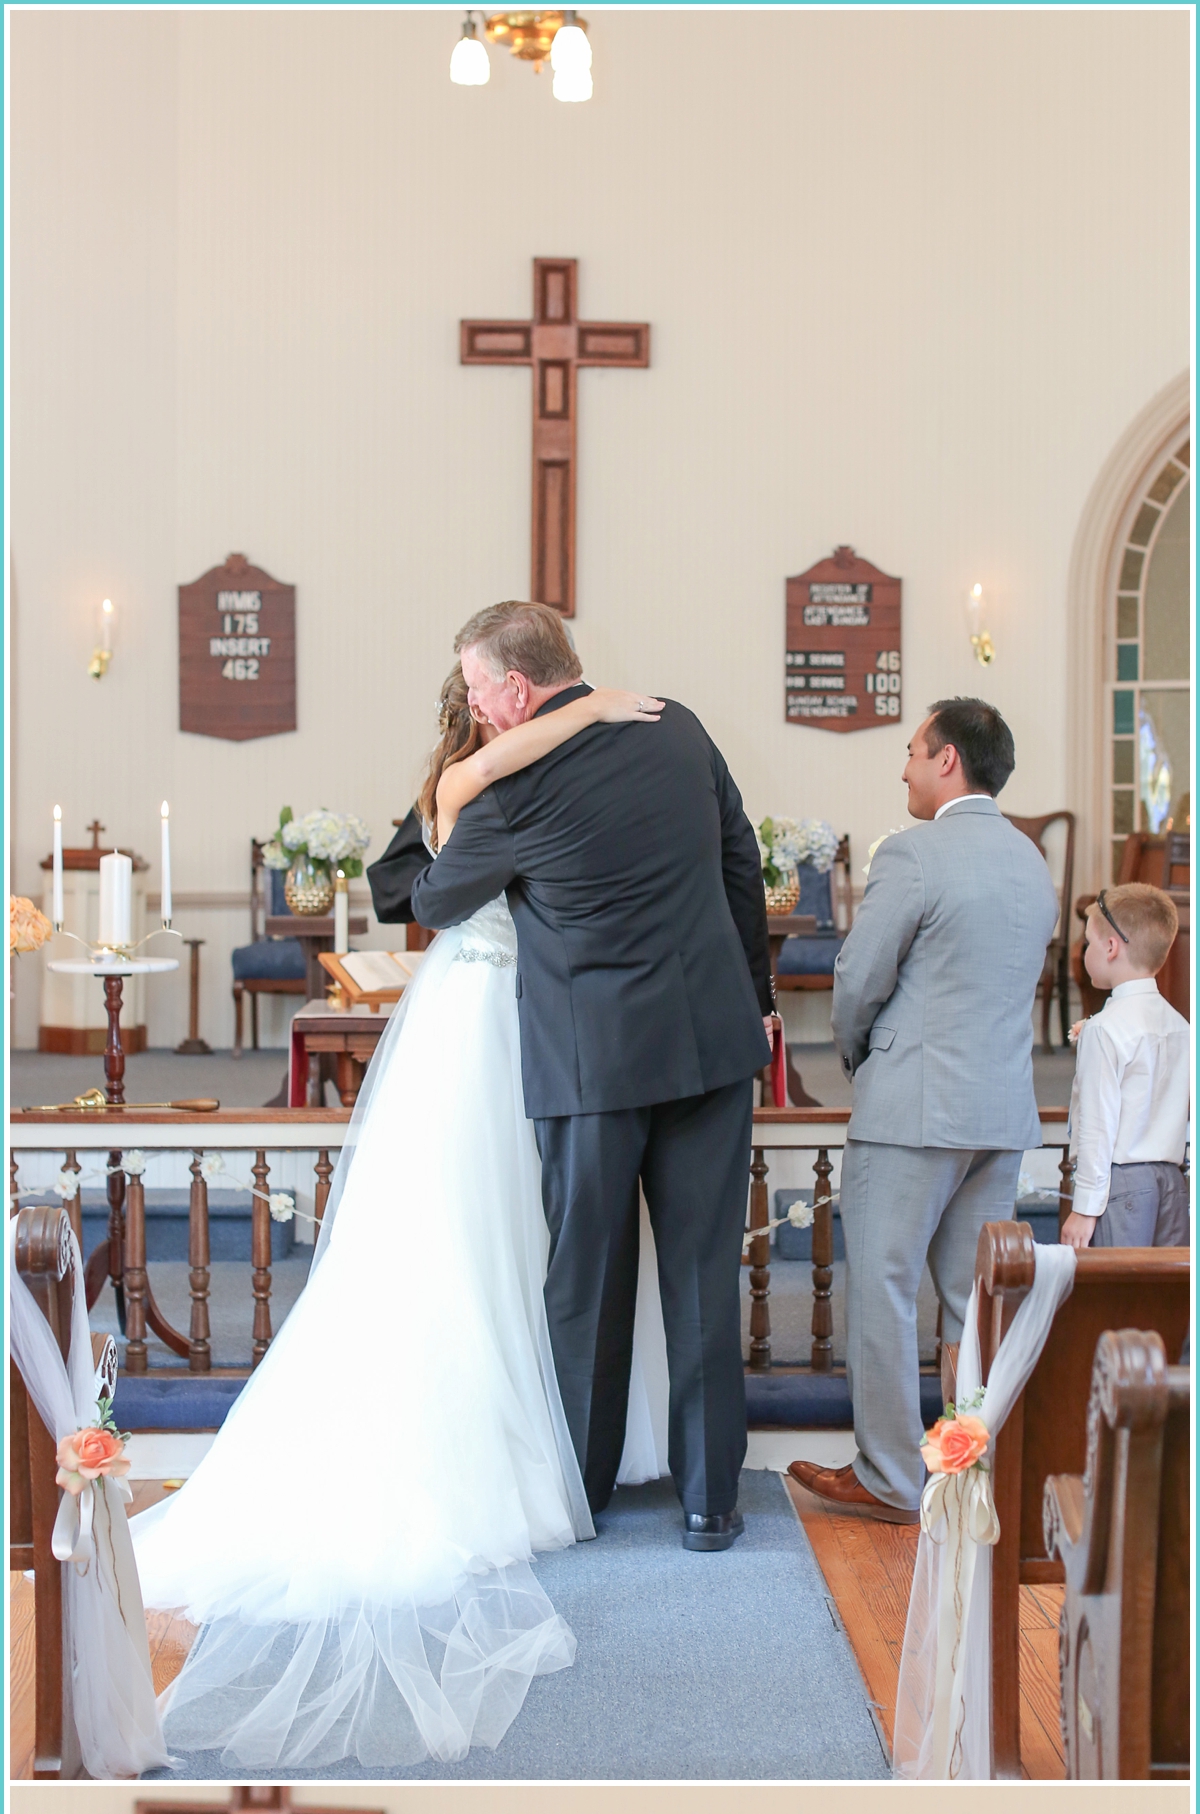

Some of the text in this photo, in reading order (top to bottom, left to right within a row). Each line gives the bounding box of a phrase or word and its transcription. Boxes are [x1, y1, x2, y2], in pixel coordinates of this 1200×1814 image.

[810, 584, 852, 593] REGISTER
[217, 590, 261, 611] HYMNS
[811, 593, 866, 603] ATTENDANCE
[804, 606, 865, 616] ATTENDANCE
[224, 614, 258, 635] 175
[804, 615, 870, 626] LAST SUNDAY
[210, 637, 270, 656] INSERT
[809, 654, 845, 666] SERVICE
[876, 651, 900, 671] 46
[222, 659, 259, 680] 462
[809, 676, 845, 689] SERVICE
[867, 674, 900, 694] 100
[787, 695, 858, 706] SUNDAY SCHOOL
[875, 696, 899, 716] 58
[788, 706, 848, 717] ATTENDANCE
